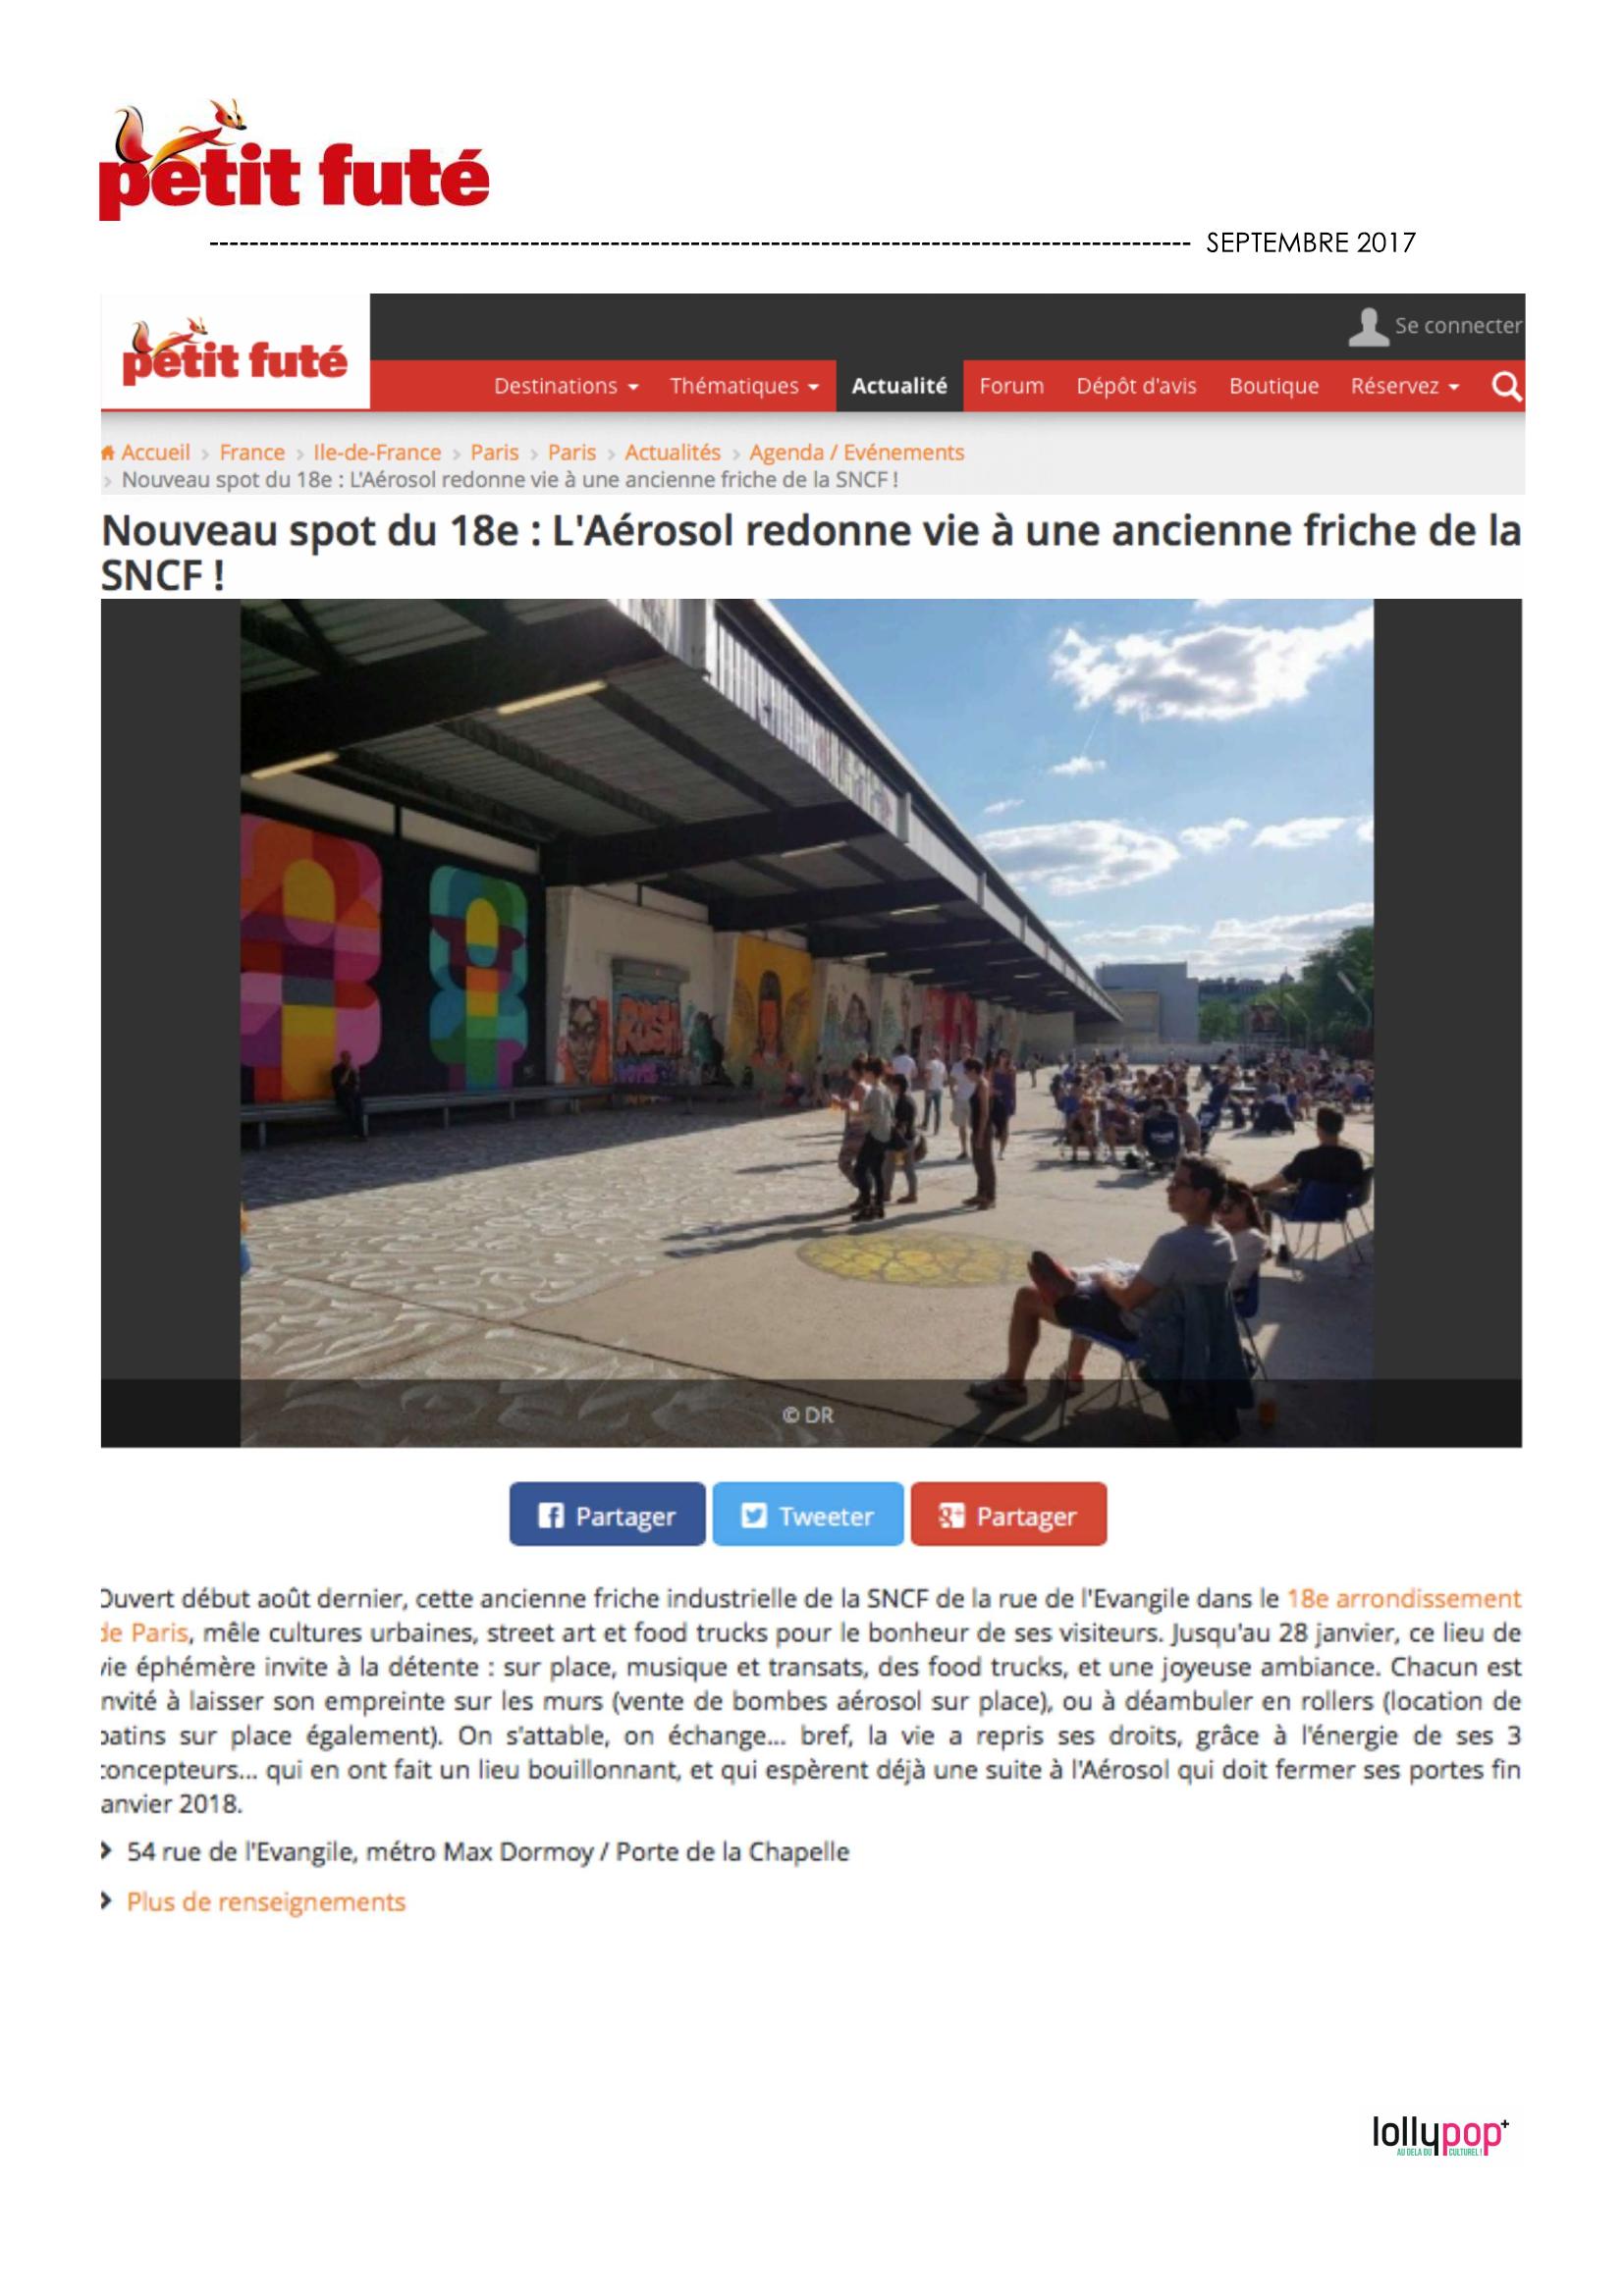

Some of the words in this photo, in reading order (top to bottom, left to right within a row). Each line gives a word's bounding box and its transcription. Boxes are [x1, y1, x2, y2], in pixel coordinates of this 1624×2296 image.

[99, 142, 300, 222] petit
[319, 142, 490, 207] futé
[1206, 231, 1349, 253] SEPTEMBRE
[1356, 231, 1417, 253] 2017
[1395, 317, 1419, 335] Se
[1424, 319, 1524, 336] connecter
[123, 341, 240, 386] petit
[249, 342, 348, 379] futé
[495, 377, 618, 395] Destinations
[670, 376, 799, 400] Thématiques
[851, 376, 948, 395] Actualité
[980, 377, 1045, 395] Forum
[1077, 376, 1137, 400] Dépôt
[1142, 377, 1197, 395] d'avis
[1230, 377, 1320, 400] Boutique
[1352, 376, 1439, 395] Réservez
[121, 443, 190, 461] Accueil
[219, 443, 286, 461] France
[314, 443, 442, 461] Ile-de-France
[470, 443, 519, 461] Paris
[548, 443, 597, 461] Paris
[624, 443, 722, 461] Actualités
[749, 443, 825, 466] Agenda
[843, 443, 965, 461] Evénements
[122, 470, 210, 489] Nouveau
[216, 472, 260, 493] spot
[264, 469, 291, 489] du
[298, 470, 333, 489] 18e
[351, 469, 436, 489] L'Aérosol
[442, 469, 526, 489] redonne
[530, 470, 560, 489] vie
[565, 469, 576, 489] à
[582, 474, 621, 489] une
[624, 470, 716, 489] ancienne
[720, 469, 778, 489] friche
[782, 469, 807, 489] de
[814, 469, 830, 489] la
[836, 470, 889, 489] SNCF
[103, 514, 276, 546] Nouveau
[290, 516, 376, 556] spot
[388, 512, 436, 546] du
[452, 514, 518, 546] 18e
[555, 512, 732, 546] L'Aérosol
[747, 512, 911, 546] redonne
[923, 513, 979, 546] vie
[992, 512, 1012, 546] à
[1026, 520, 1101, 547] une
[1112, 513, 1292, 546] ancienne
[1304, 512, 1417, 546] friche
[1430, 512, 1477, 546] de
[1490, 512, 1521, 546] la
[102, 560, 202, 591] SNCF
[576, 1506, 677, 1533] Partager
[779, 1506, 875, 1527] Tweeter
[977, 1506, 1078, 1533] Partager
[181, 1586, 251, 1609] début
[257, 1585, 312, 1609] août
[316, 1586, 408, 1611] dernier,
[414, 1589, 474, 1609] cette
[479, 1587, 587, 1609] ancienne
[593, 1585, 661, 1609] friche
[667, 1586, 798, 1609] industrielle
[803, 1586, 835, 1609] de
[841, 1586, 860, 1609] la
[866, 1587, 930, 1609] SNCF
[935, 1586, 965, 1609] de
[971, 1586, 993, 1609] la
[999, 1592, 1038, 1609] rue
[1044, 1586, 1075, 1609] de
[1081, 1586, 1191, 1616] l'Evangile
[1196, 1586, 1254, 1609] dans
[1259, 1586, 1279, 1609] le
[1287, 1587, 1329, 1610] 18e
[1335, 1588, 1523, 1610] arrondissement
[131, 1622, 194, 1645] Paris,
[203, 1620, 260, 1643] mêle
[268, 1621, 363, 1643] cultures
[369, 1621, 479, 1645] urbaines,
[486, 1624, 556, 1643] street
[561, 1623, 597, 1643] art
[602, 1624, 627, 1643] et
[632, 1620, 688, 1643] food
[695, 1621, 769, 1643] trucks
[775, 1627, 834, 1649] pour
[839, 1621, 860, 1643] le
[868, 1621, 970, 1643] bonheur
[975, 1621, 1006, 1643] de
[1014, 1627, 1054, 1643] ses
[1058, 1622, 1164, 1643] visiteurs.
[1169, 1622, 1271, 1649] Jusqu'au
[1278, 1622, 1309, 1643] 28
[1314, 1622, 1400, 1649] janvier,
[1409, 1627, 1435, 1643] ce
[1443, 1621, 1485, 1643] lieu
[1491, 1621, 1523, 1643] de
[265, 1759, 303, 1787] qui
[309, 1763, 341, 1781] en
[347, 1761, 388, 1781] ont
[393, 1757, 433, 1781] fait
[440, 1763, 470, 1781] un
[478, 1758, 520, 1781] lieu
[527, 1758, 682, 1783] bouillonnant,
[688, 1761, 715, 1781] et
[720, 1759, 758, 1786] qui
[765, 1757, 870, 1786] espèrent
[876, 1757, 926, 1787] déjà
[933, 1763, 979, 1781] une
[985, 1759, 1043, 1781] suite
[1049, 1757, 1063, 1781] à
[1071, 1757, 1170, 1781] l'Aérosol
[1176, 1759, 1215, 1787] qui
[1221, 1757, 1269, 1781] doit
[1274, 1757, 1357, 1781] fermer
[1363, 1763, 1401, 1781] ses
[1409, 1760, 1485, 1787] portes
[1490, 1757, 1521, 1780] fin
[100, 1792, 174, 1815] anvier
[178, 1792, 244, 1815] 2018.
[128, 1841, 157, 1862] 54
[162, 1845, 202, 1862] rue
[207, 1840, 238, 1862] de
[244, 1840, 358, 1869] l'Evangile,
[365, 1840, 437, 1862] métro
[443, 1841, 494, 1862] Max
[499, 1841, 595, 1869] Dormoy
[616, 1841, 679, 1862] Porte
[685, 1840, 717, 1862] de
[723, 1840, 742, 1862] la
[748, 1840, 851, 1868] Chapelle
[127, 1891, 176, 1912] Plus
[182, 1891, 212, 1913] de
[219, 1892, 406, 1918] renseignements
[1448, 2148, 1479, 2157] CULTUREL
